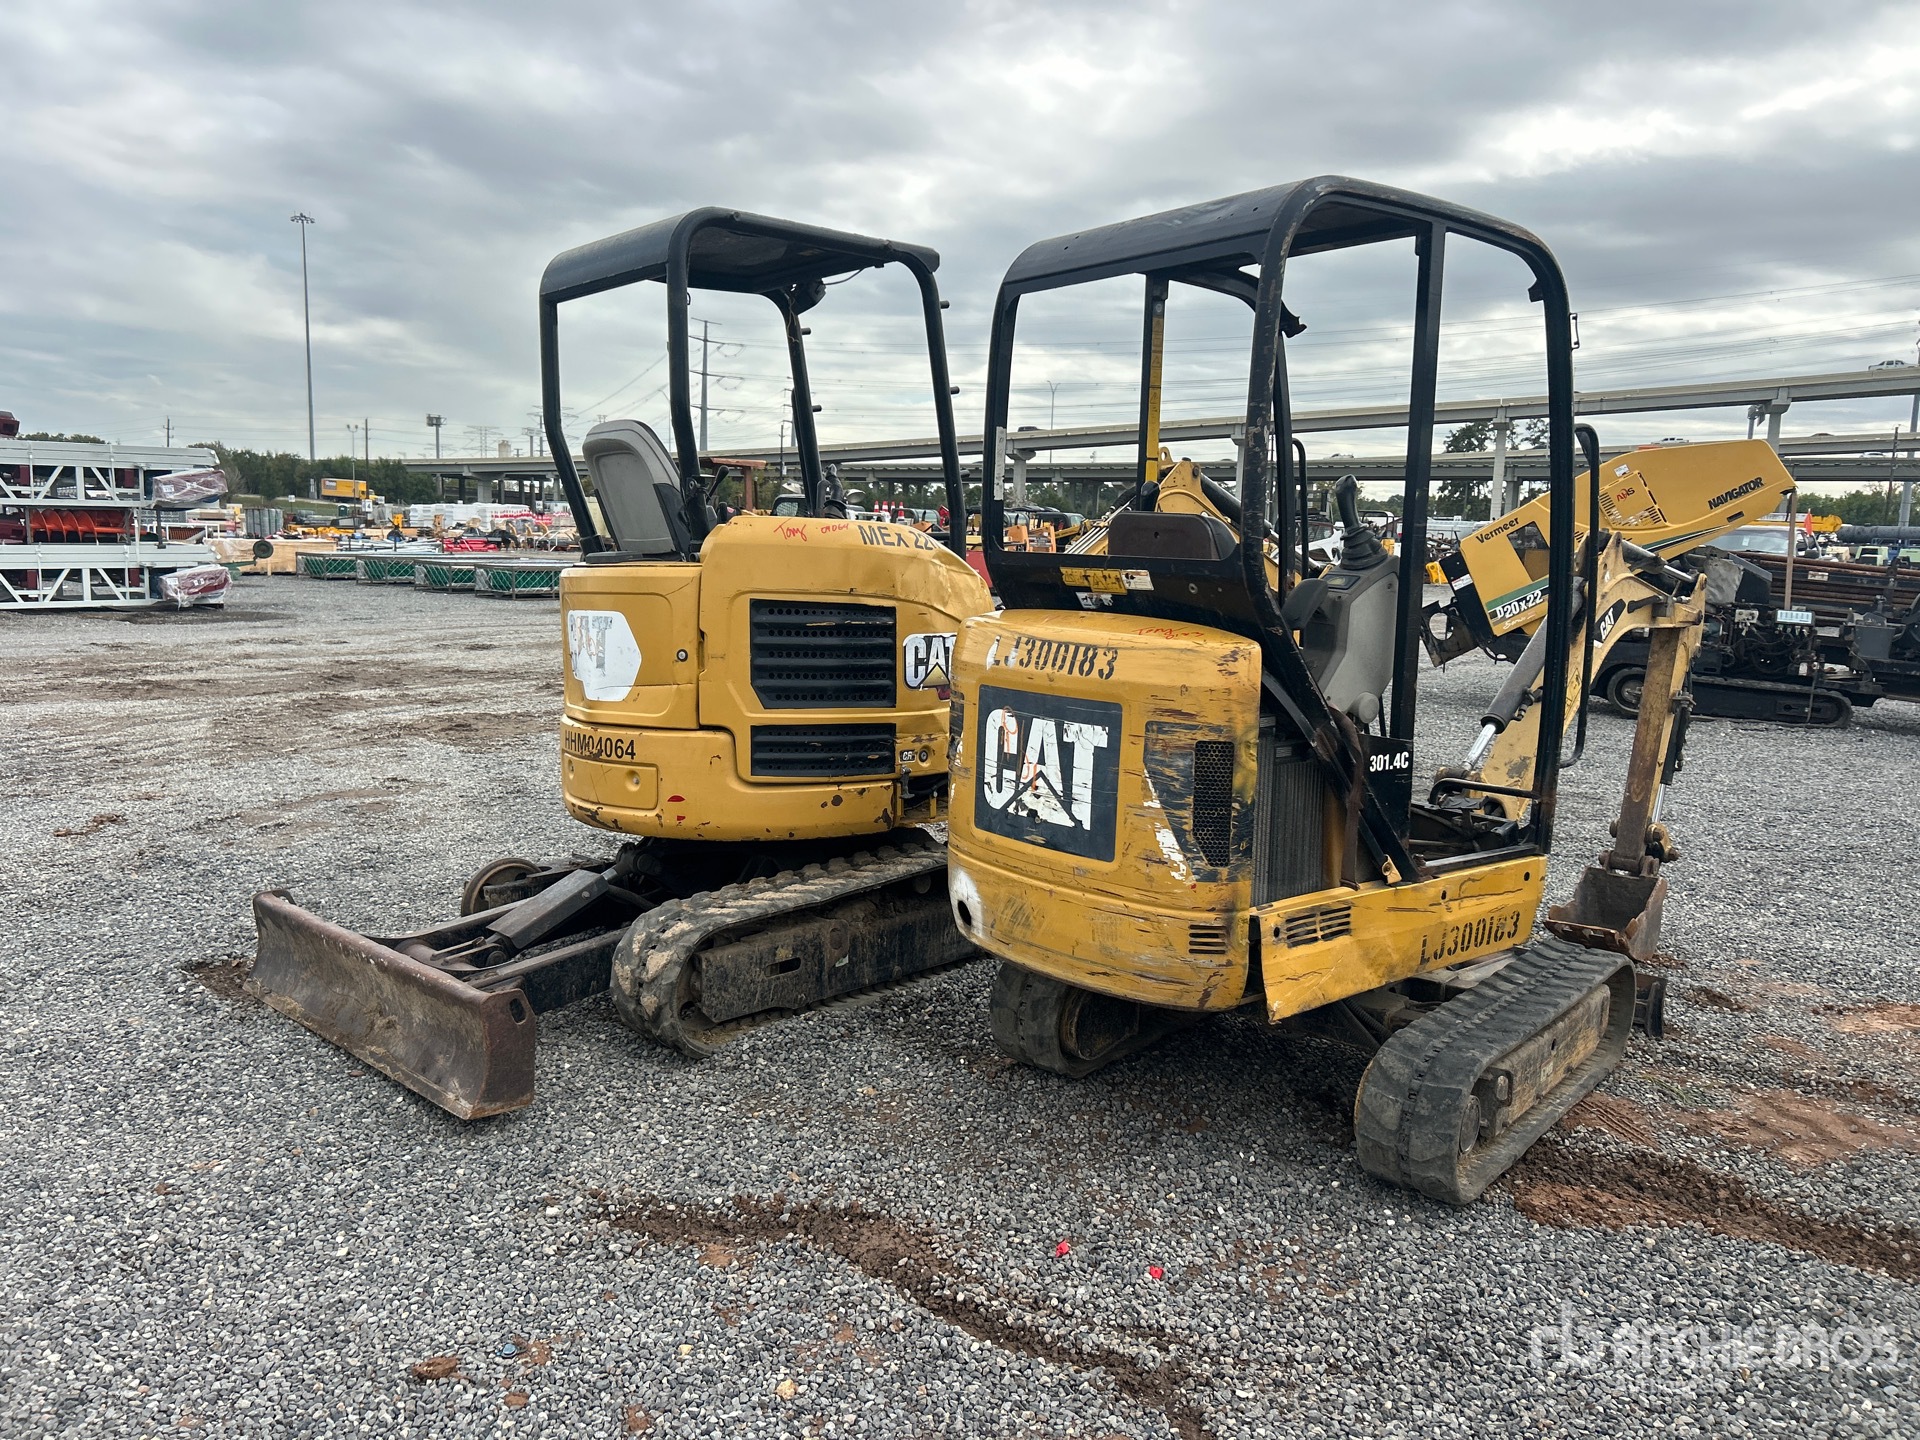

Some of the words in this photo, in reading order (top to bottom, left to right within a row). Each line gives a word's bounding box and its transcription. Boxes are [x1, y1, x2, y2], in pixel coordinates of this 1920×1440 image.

[1708, 476, 1765, 510] NAVIGATOR
[1475, 517, 1520, 544] Vermeer
[1495, 590, 1544, 620] D20x22
[1600, 607, 1615, 640] CAT
[986, 635, 1119, 680] LJ300183
[564, 729, 636, 760] HHM04064
[983, 708, 1109, 831] CAT
[1369, 751, 1409, 773] 301.4C
[1420, 910, 1521, 965] LJ300183
